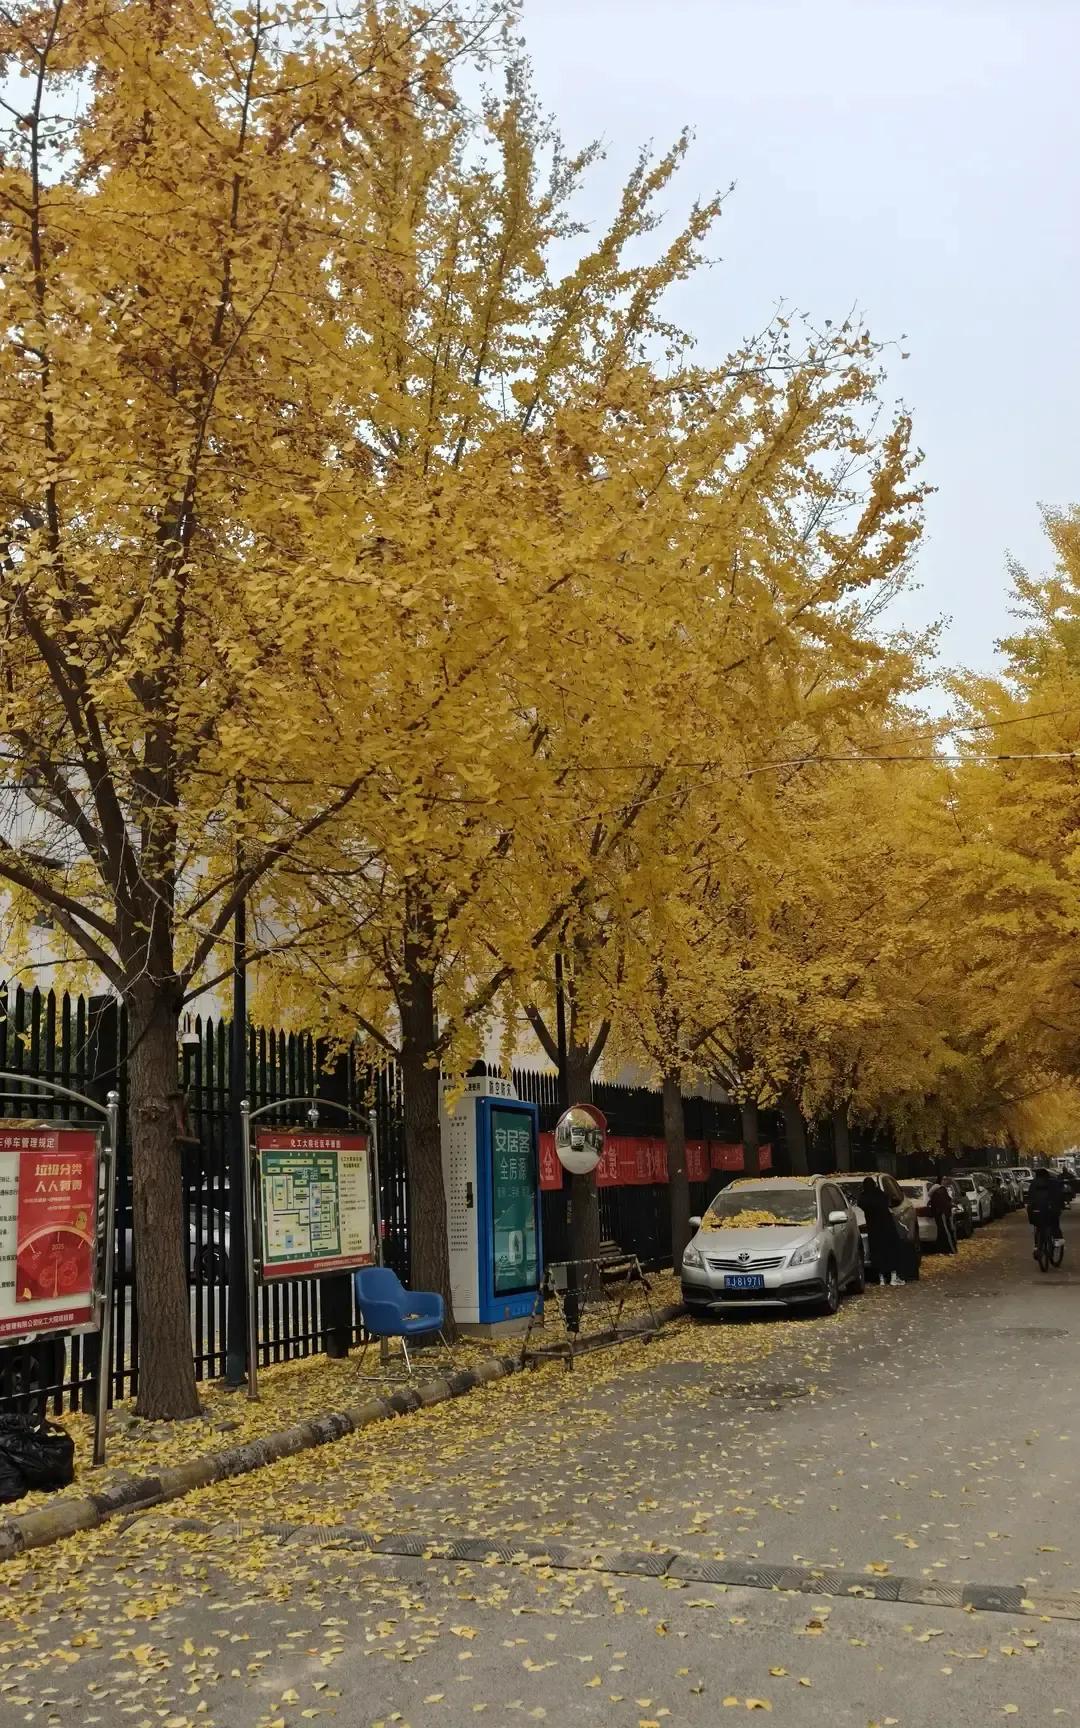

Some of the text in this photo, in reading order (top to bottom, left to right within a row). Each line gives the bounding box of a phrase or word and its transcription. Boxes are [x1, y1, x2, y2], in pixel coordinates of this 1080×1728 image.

[495, 1128, 530, 1153] 安居客
[35, 1163, 83, 1177] 垃圾分类
[500, 1156, 528, 1181] 全房源
